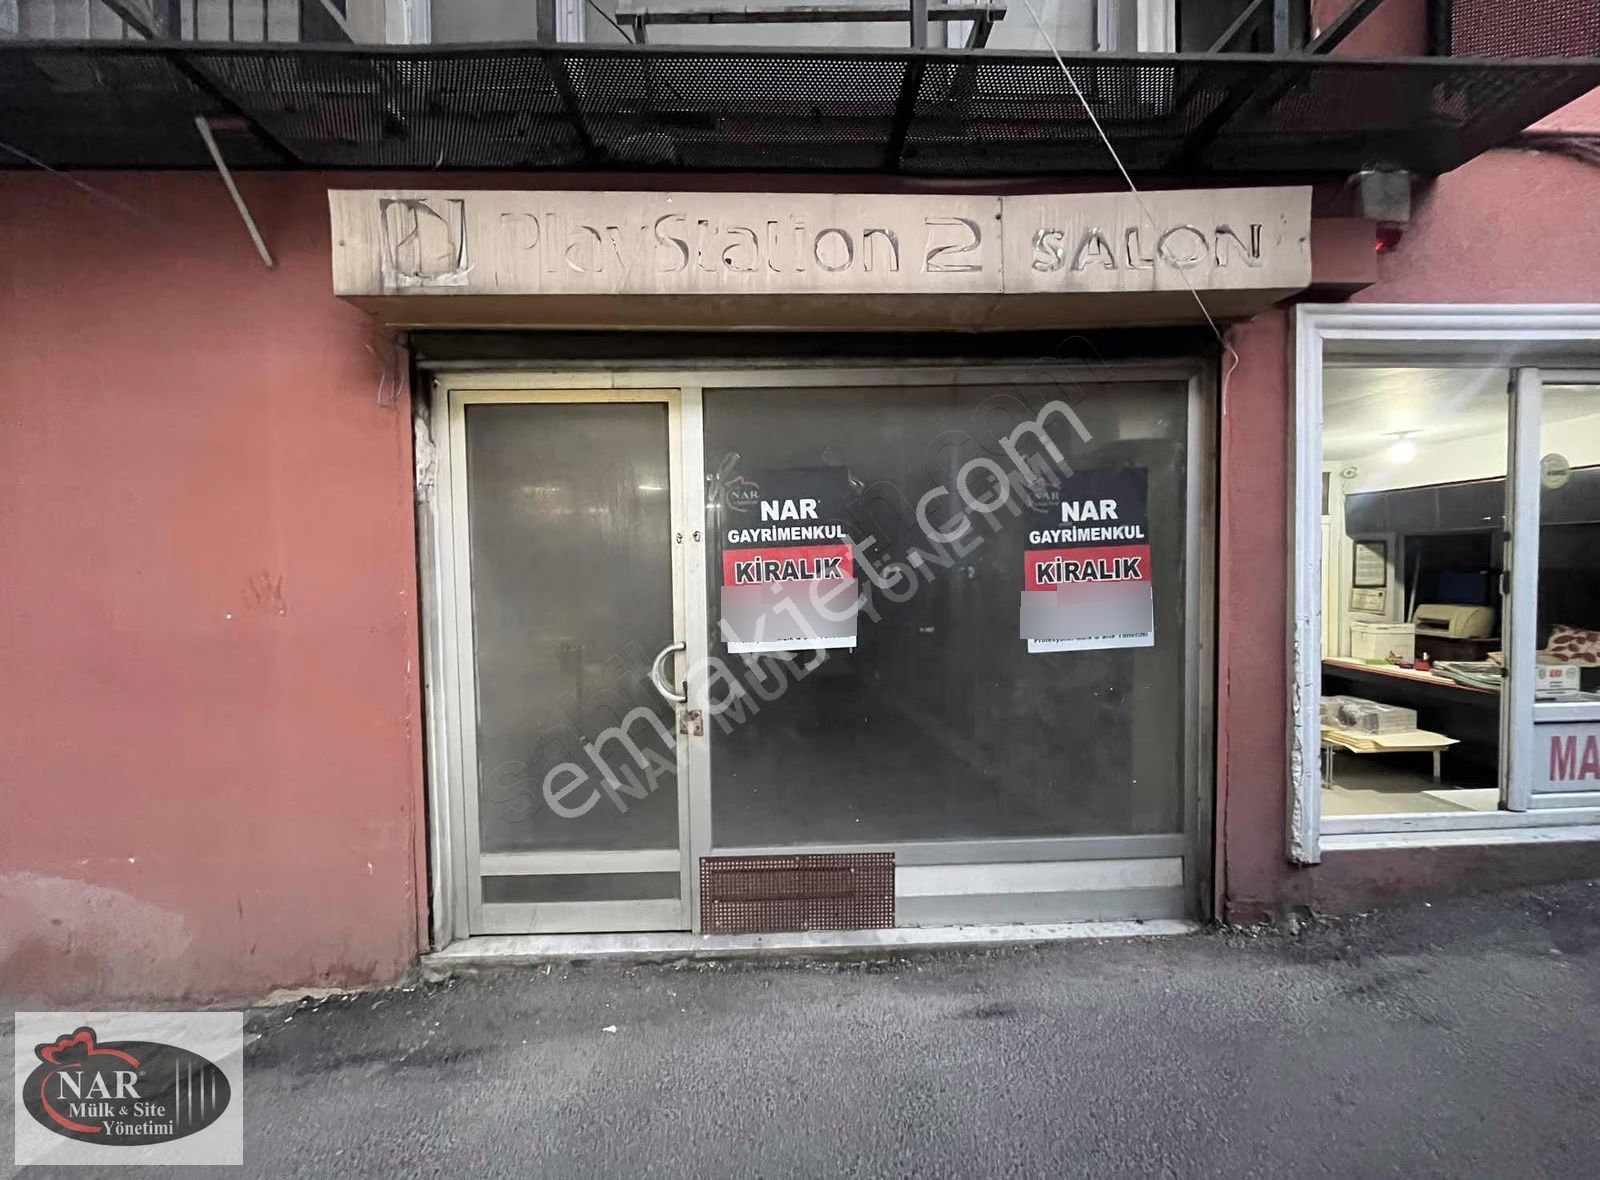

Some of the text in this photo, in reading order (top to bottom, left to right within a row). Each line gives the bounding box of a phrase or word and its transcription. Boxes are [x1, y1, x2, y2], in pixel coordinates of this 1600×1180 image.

[925, 216, 983, 272] 2
[1032, 223, 1263, 272] SALON
[761, 498, 819, 521] NAR
[1061, 500, 1119, 522] NAR
[727, 525, 847, 544] GAYRİMENKUL
[1029, 525, 1145, 545] GAYRİMENKUL
[734, 556, 844, 584] KİRALIK
[1035, 556, 1142, 585] KİRALIK
